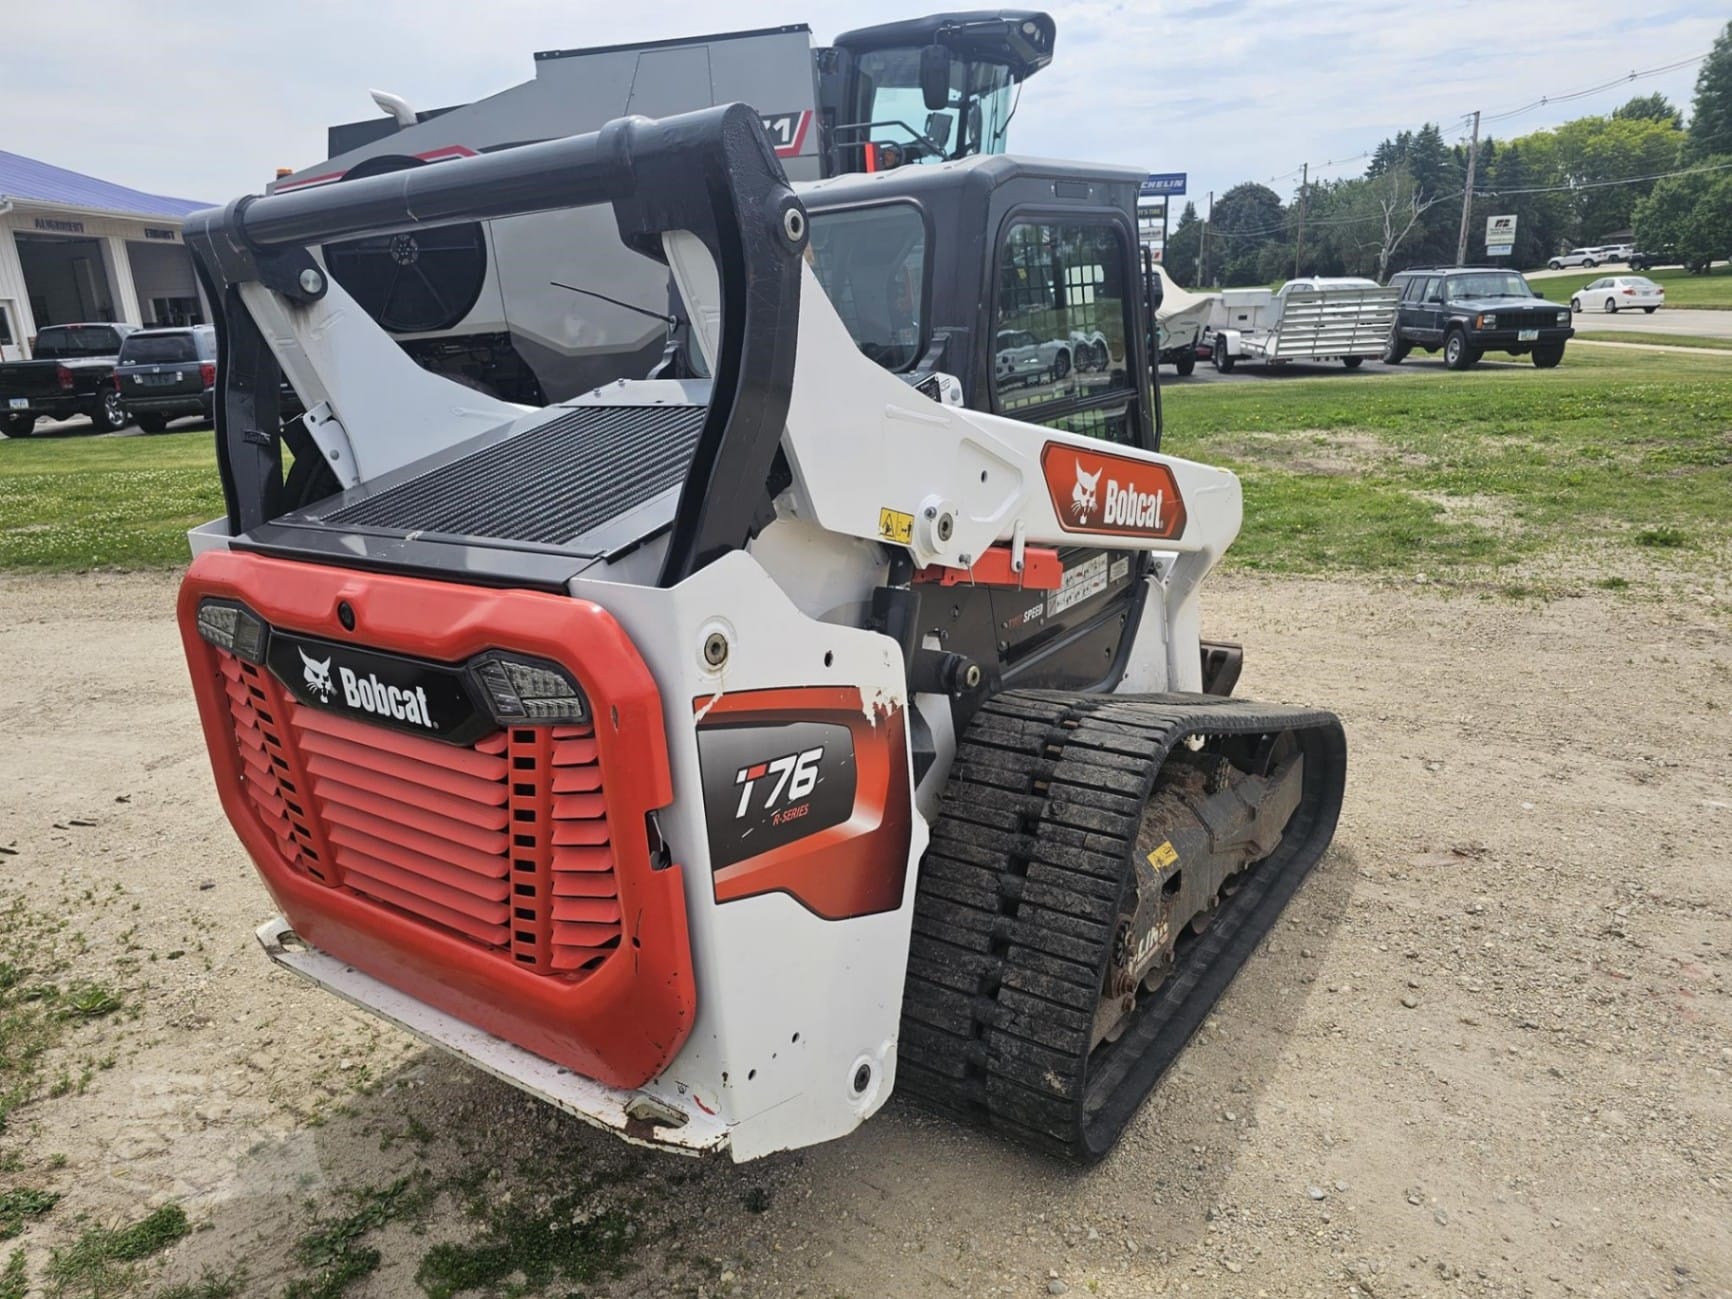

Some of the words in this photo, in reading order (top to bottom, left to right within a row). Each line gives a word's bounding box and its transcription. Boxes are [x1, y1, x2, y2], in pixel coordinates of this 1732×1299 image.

[1141, 180, 1184, 189] CHELIN
[1103, 479, 1163, 529] Bobcat
[1023, 603, 1043, 623] SPEED
[339, 666, 432, 728] Bobcat
[735, 746, 824, 819] T76
[772, 803, 810, 826] R-SERIES
